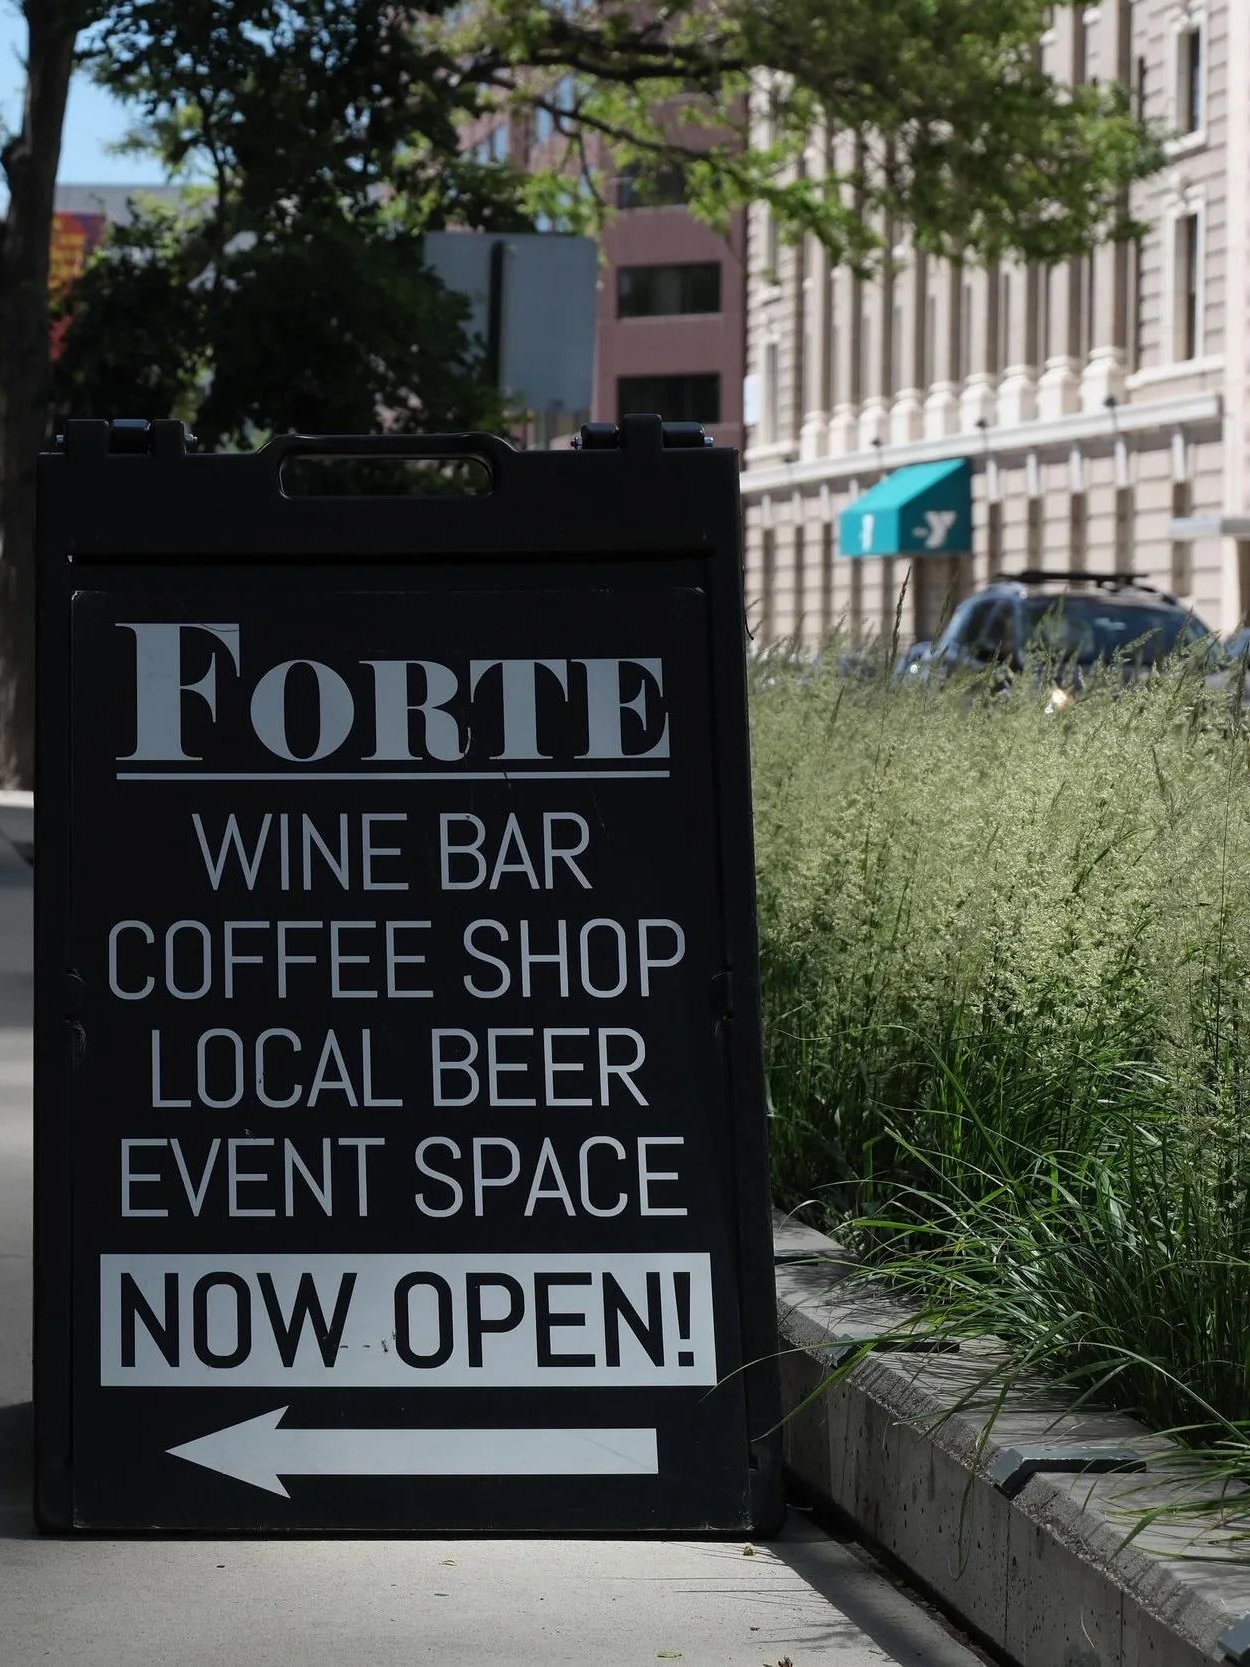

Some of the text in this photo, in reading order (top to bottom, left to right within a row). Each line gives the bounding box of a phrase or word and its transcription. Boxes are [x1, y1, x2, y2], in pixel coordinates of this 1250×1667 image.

[116, 624, 670, 762] FORTE
[192, 812, 593, 891] WINE BAR
[109, 918, 686, 1000] COFFEE SHOP
[151, 1027, 650, 1109] LOCAL BEER
[121, 1136, 688, 1218] EVENT SPACE
[120, 1271, 696, 1370] NOW OPEN!
